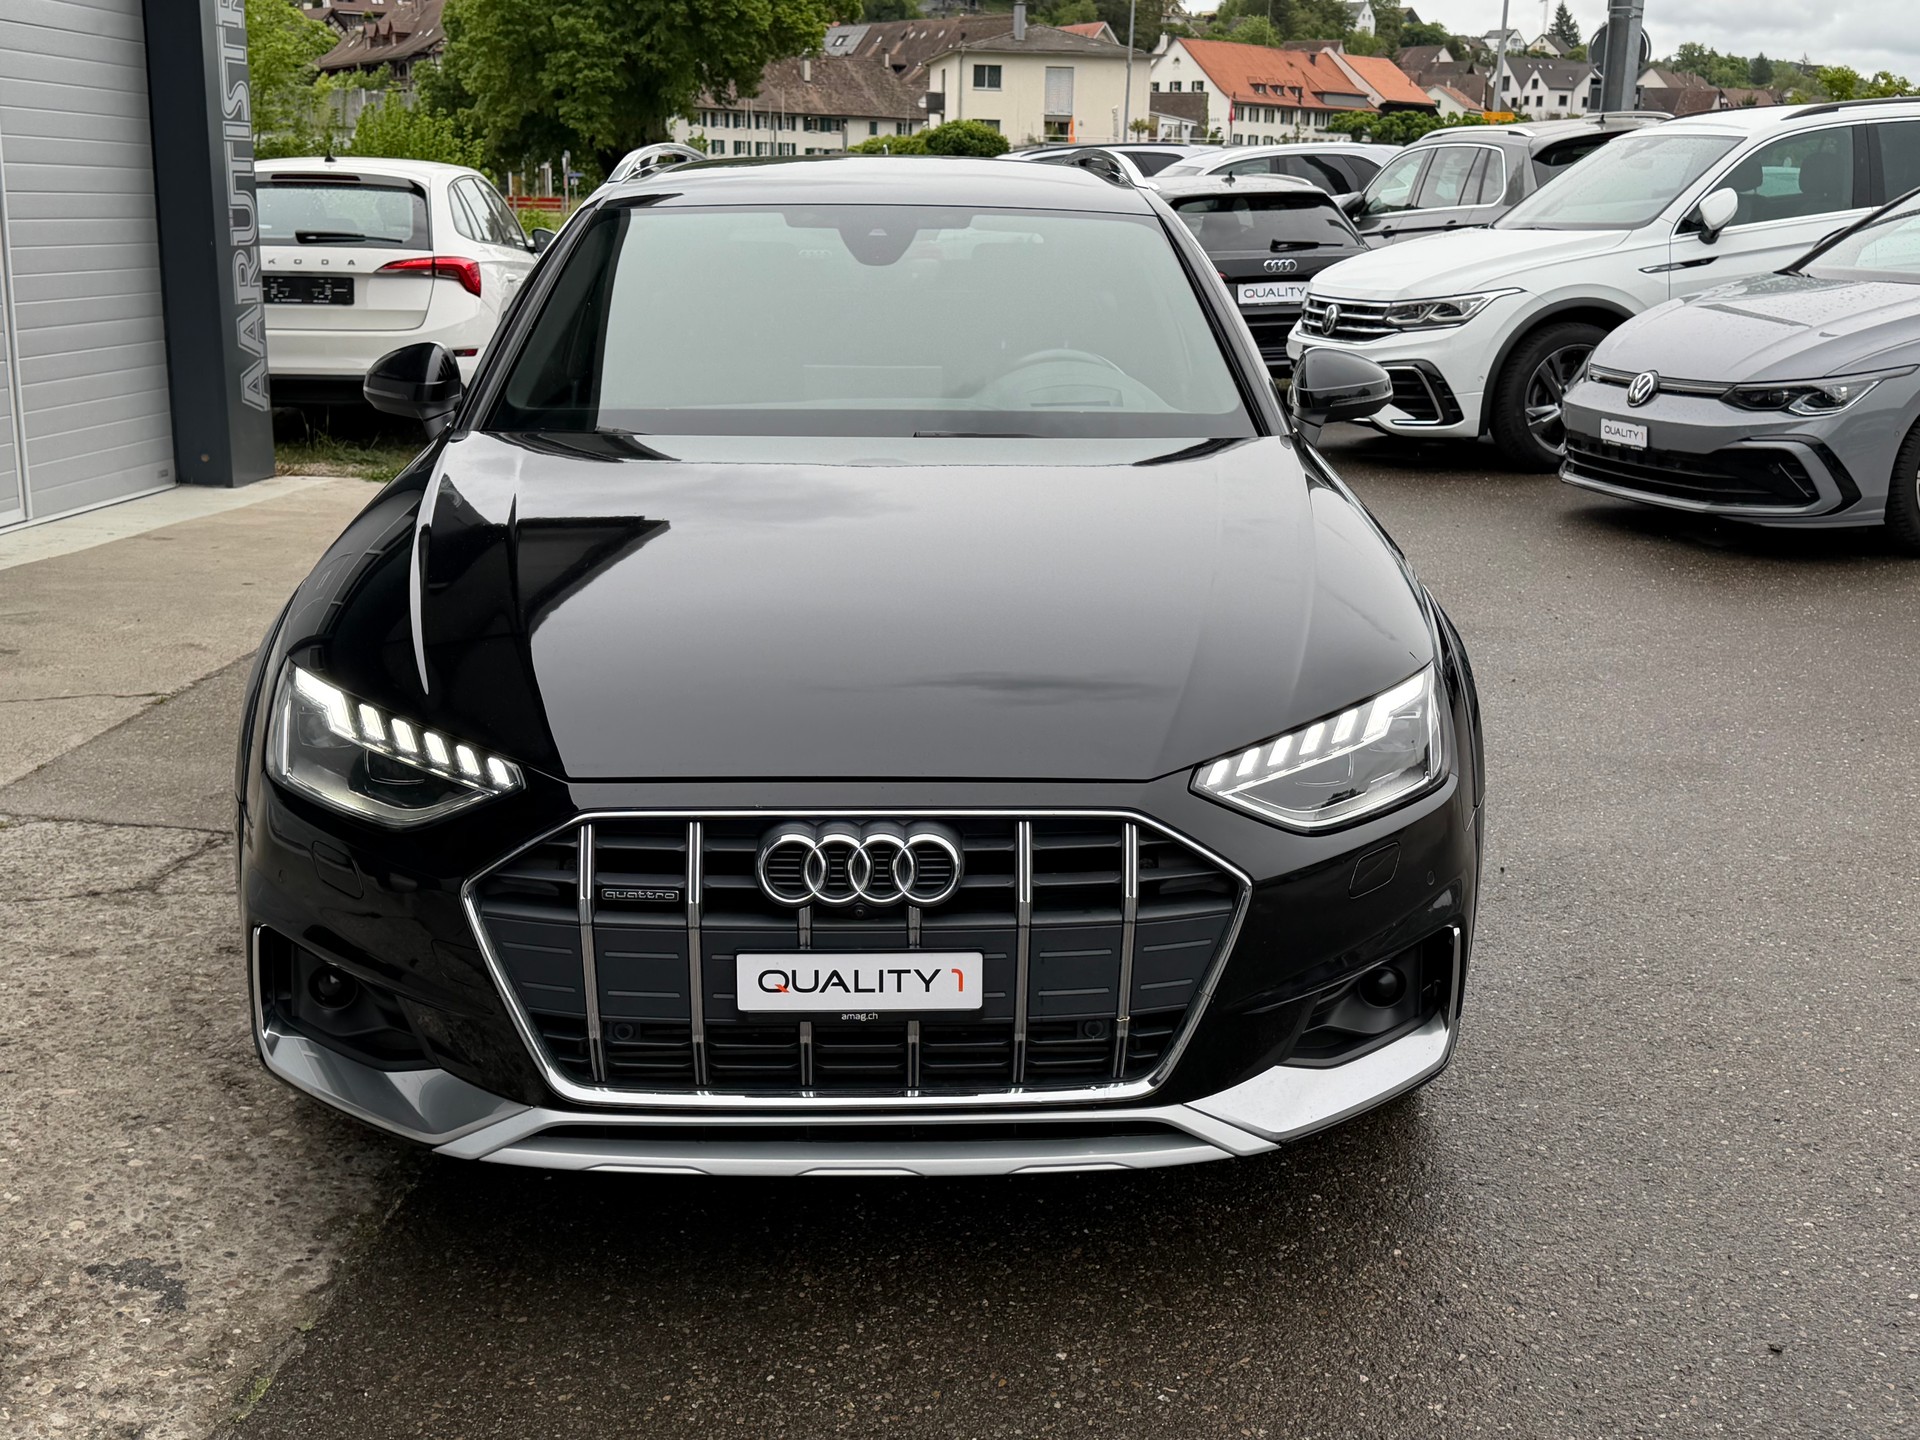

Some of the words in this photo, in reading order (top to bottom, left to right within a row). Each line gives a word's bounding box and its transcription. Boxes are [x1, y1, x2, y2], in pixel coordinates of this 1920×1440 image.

[1243, 286, 1306, 299] QUALITY
[604, 890, 676, 900] quattro
[757, 968, 942, 994] QUALITY
[951, 967, 964, 993] 1
[841, 1011, 879, 1022] amag.ch
